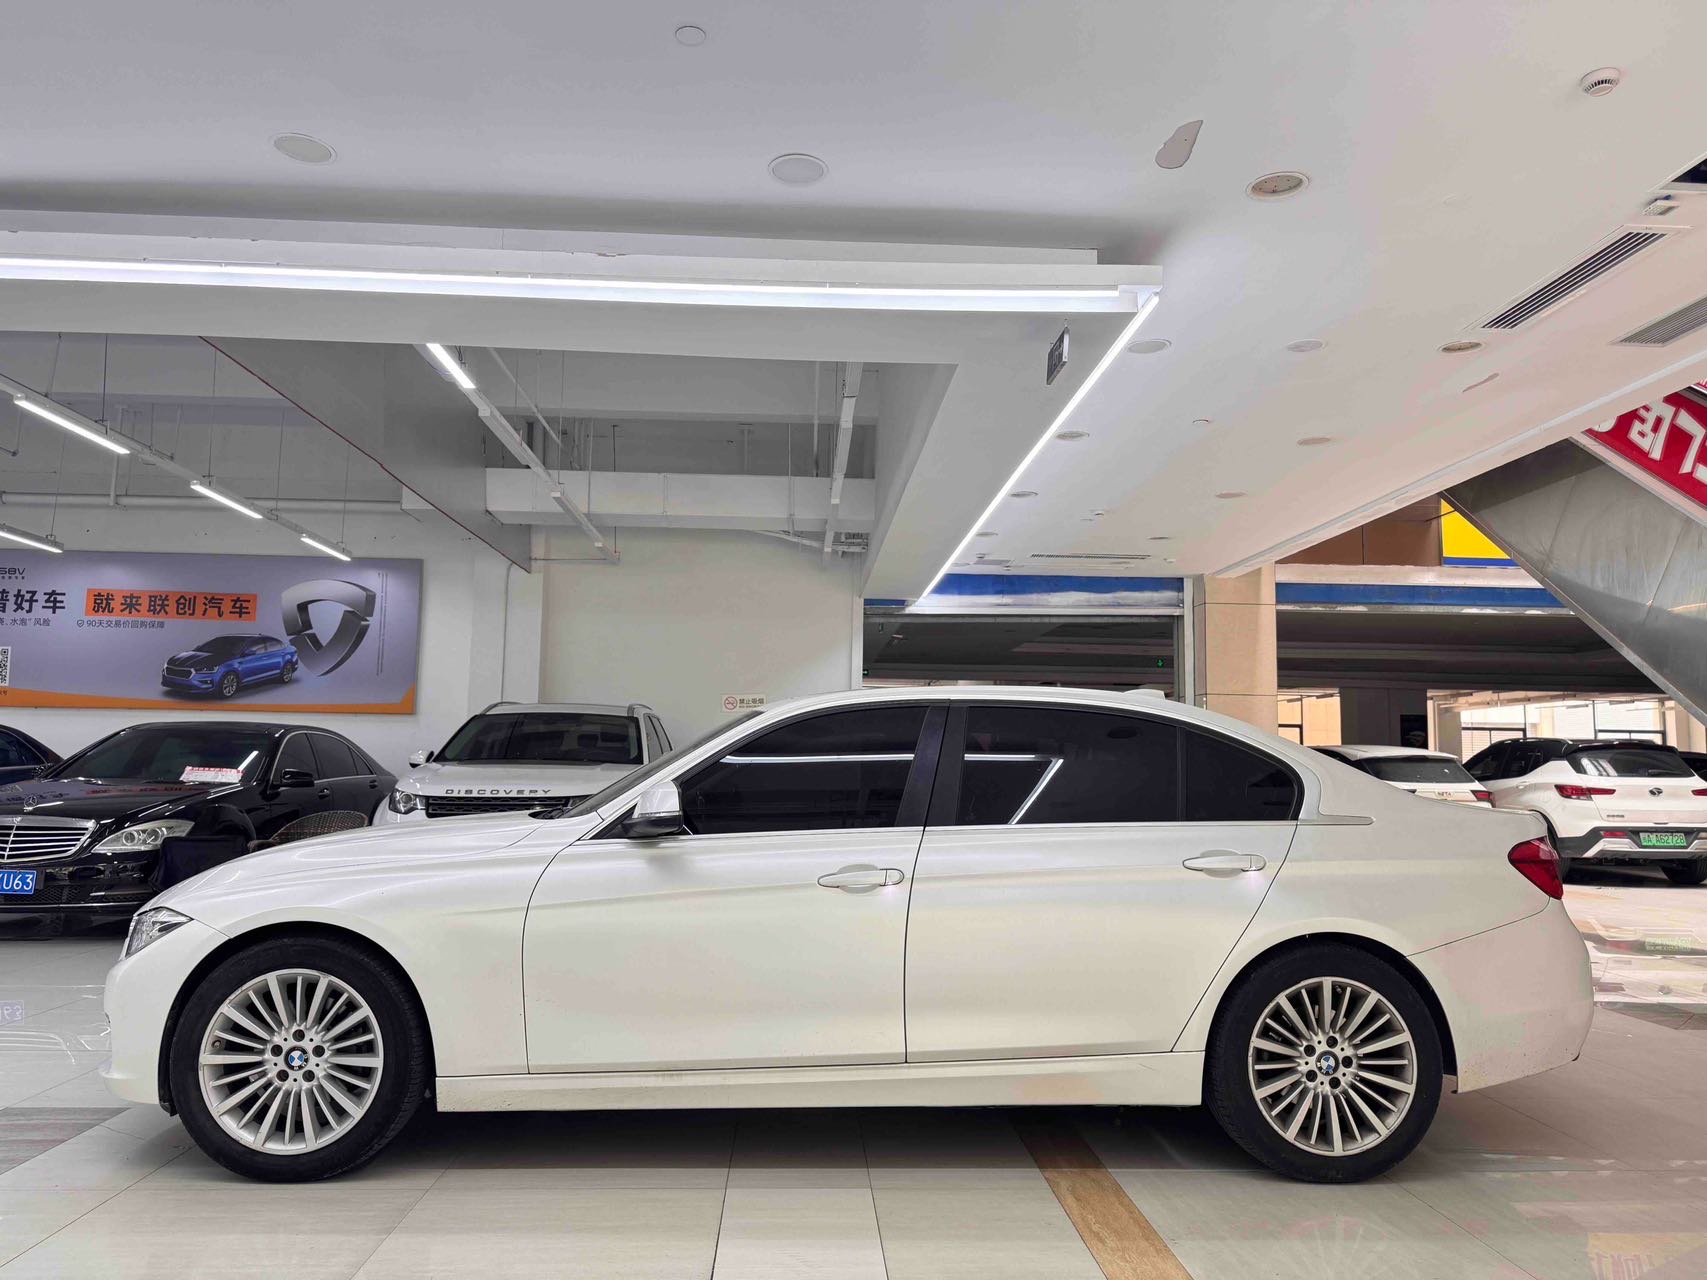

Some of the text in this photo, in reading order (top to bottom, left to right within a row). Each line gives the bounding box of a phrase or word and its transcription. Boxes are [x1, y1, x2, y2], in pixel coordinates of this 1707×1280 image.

[92, 592, 251, 618] 就来联创汽车
[86, 619, 165, 629] 90天交易价回购保障
[445, 788, 552, 796] DISCOVERY
[0, 873, 34, 891] U63
